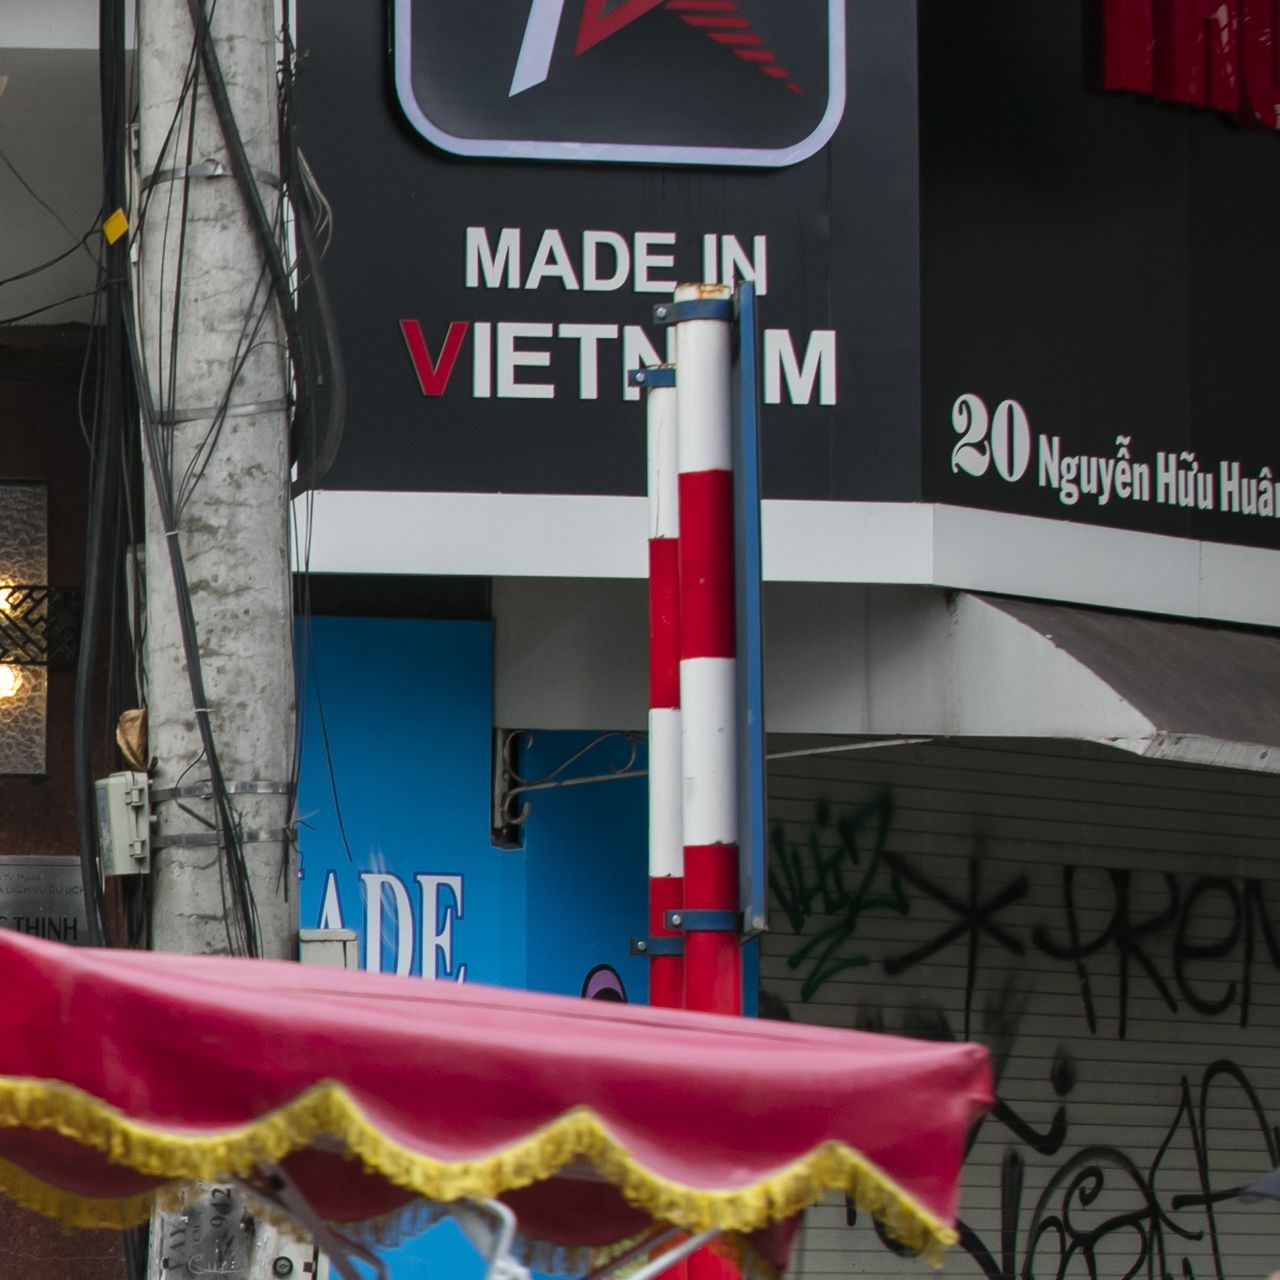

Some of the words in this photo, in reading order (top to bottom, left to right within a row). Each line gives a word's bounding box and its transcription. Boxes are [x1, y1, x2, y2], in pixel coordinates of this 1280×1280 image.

[465, 226, 678, 294] MADE
[703, 233, 768, 296] IN
[399, 319, 837, 405] VIETNM
[951, 393, 1031, 483] 20
[1038, 434, 1150, 505] Nguyễn
[1156, 450, 1214, 510] Hữu
[1220, 460, 1280, 518] Huâ
